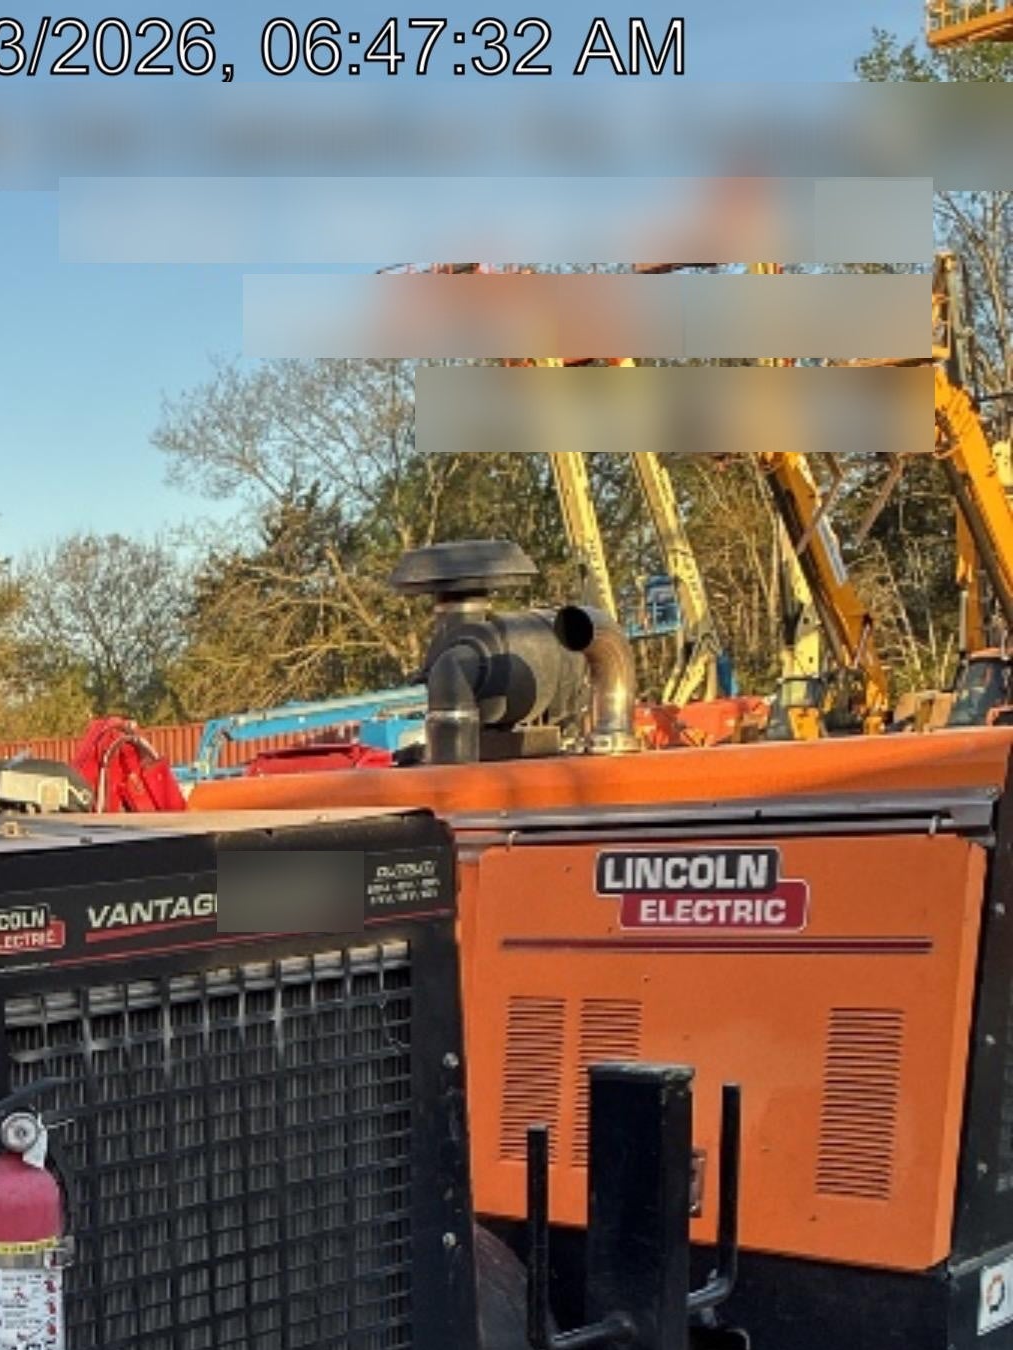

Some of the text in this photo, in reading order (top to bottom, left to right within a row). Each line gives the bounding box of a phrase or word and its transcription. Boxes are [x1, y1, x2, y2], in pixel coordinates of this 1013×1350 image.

[604, 855, 769, 889] LINCOLN
[87, 893, 218, 929] VANTAG
[640, 899, 786, 924] ELECTRIC
